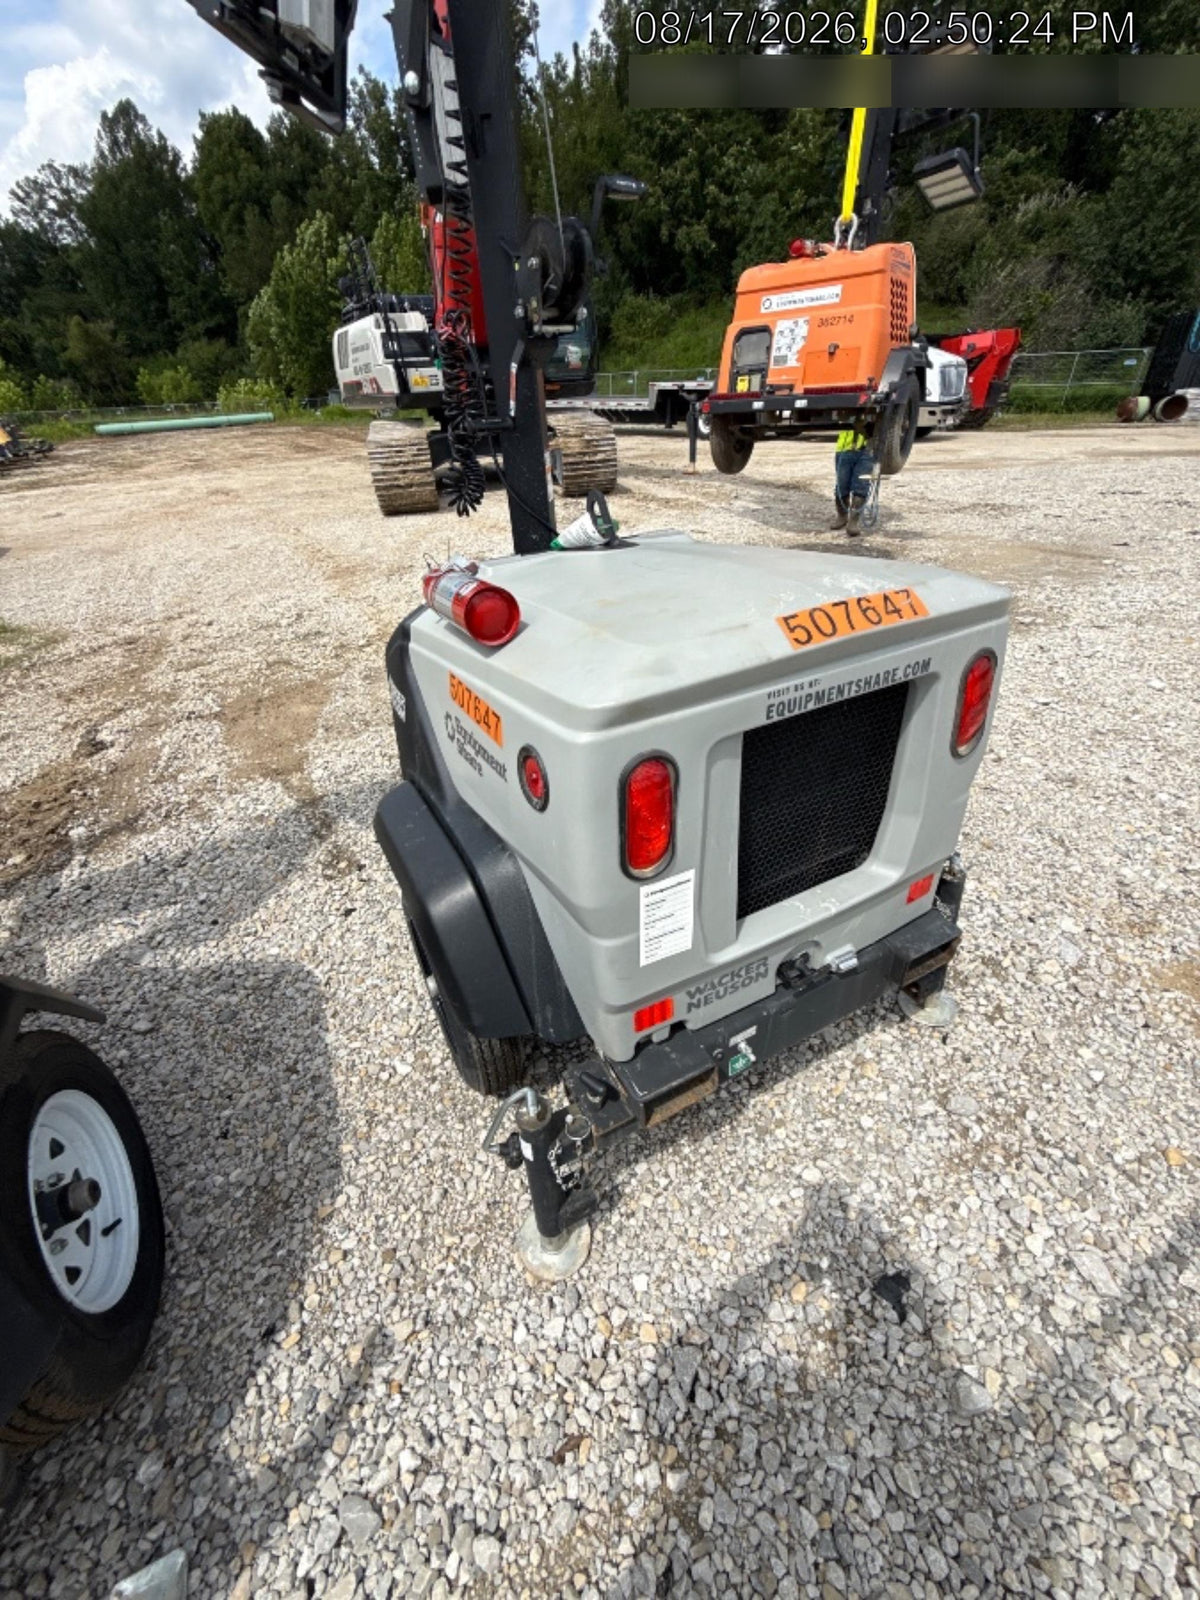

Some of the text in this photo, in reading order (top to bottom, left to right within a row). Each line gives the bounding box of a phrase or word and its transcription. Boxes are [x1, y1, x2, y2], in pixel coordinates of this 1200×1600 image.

[782, 588, 918, 646] 507647
[448, 672, 501, 743] 507647
[766, 657, 933, 721] EQUIPMENTSHARE.COM
[767, 684, 791, 700] VISIT
[454, 715, 508, 783] Equipment
[685, 956, 769, 1000] WACKER
[686, 967, 769, 1014] NEUSON
